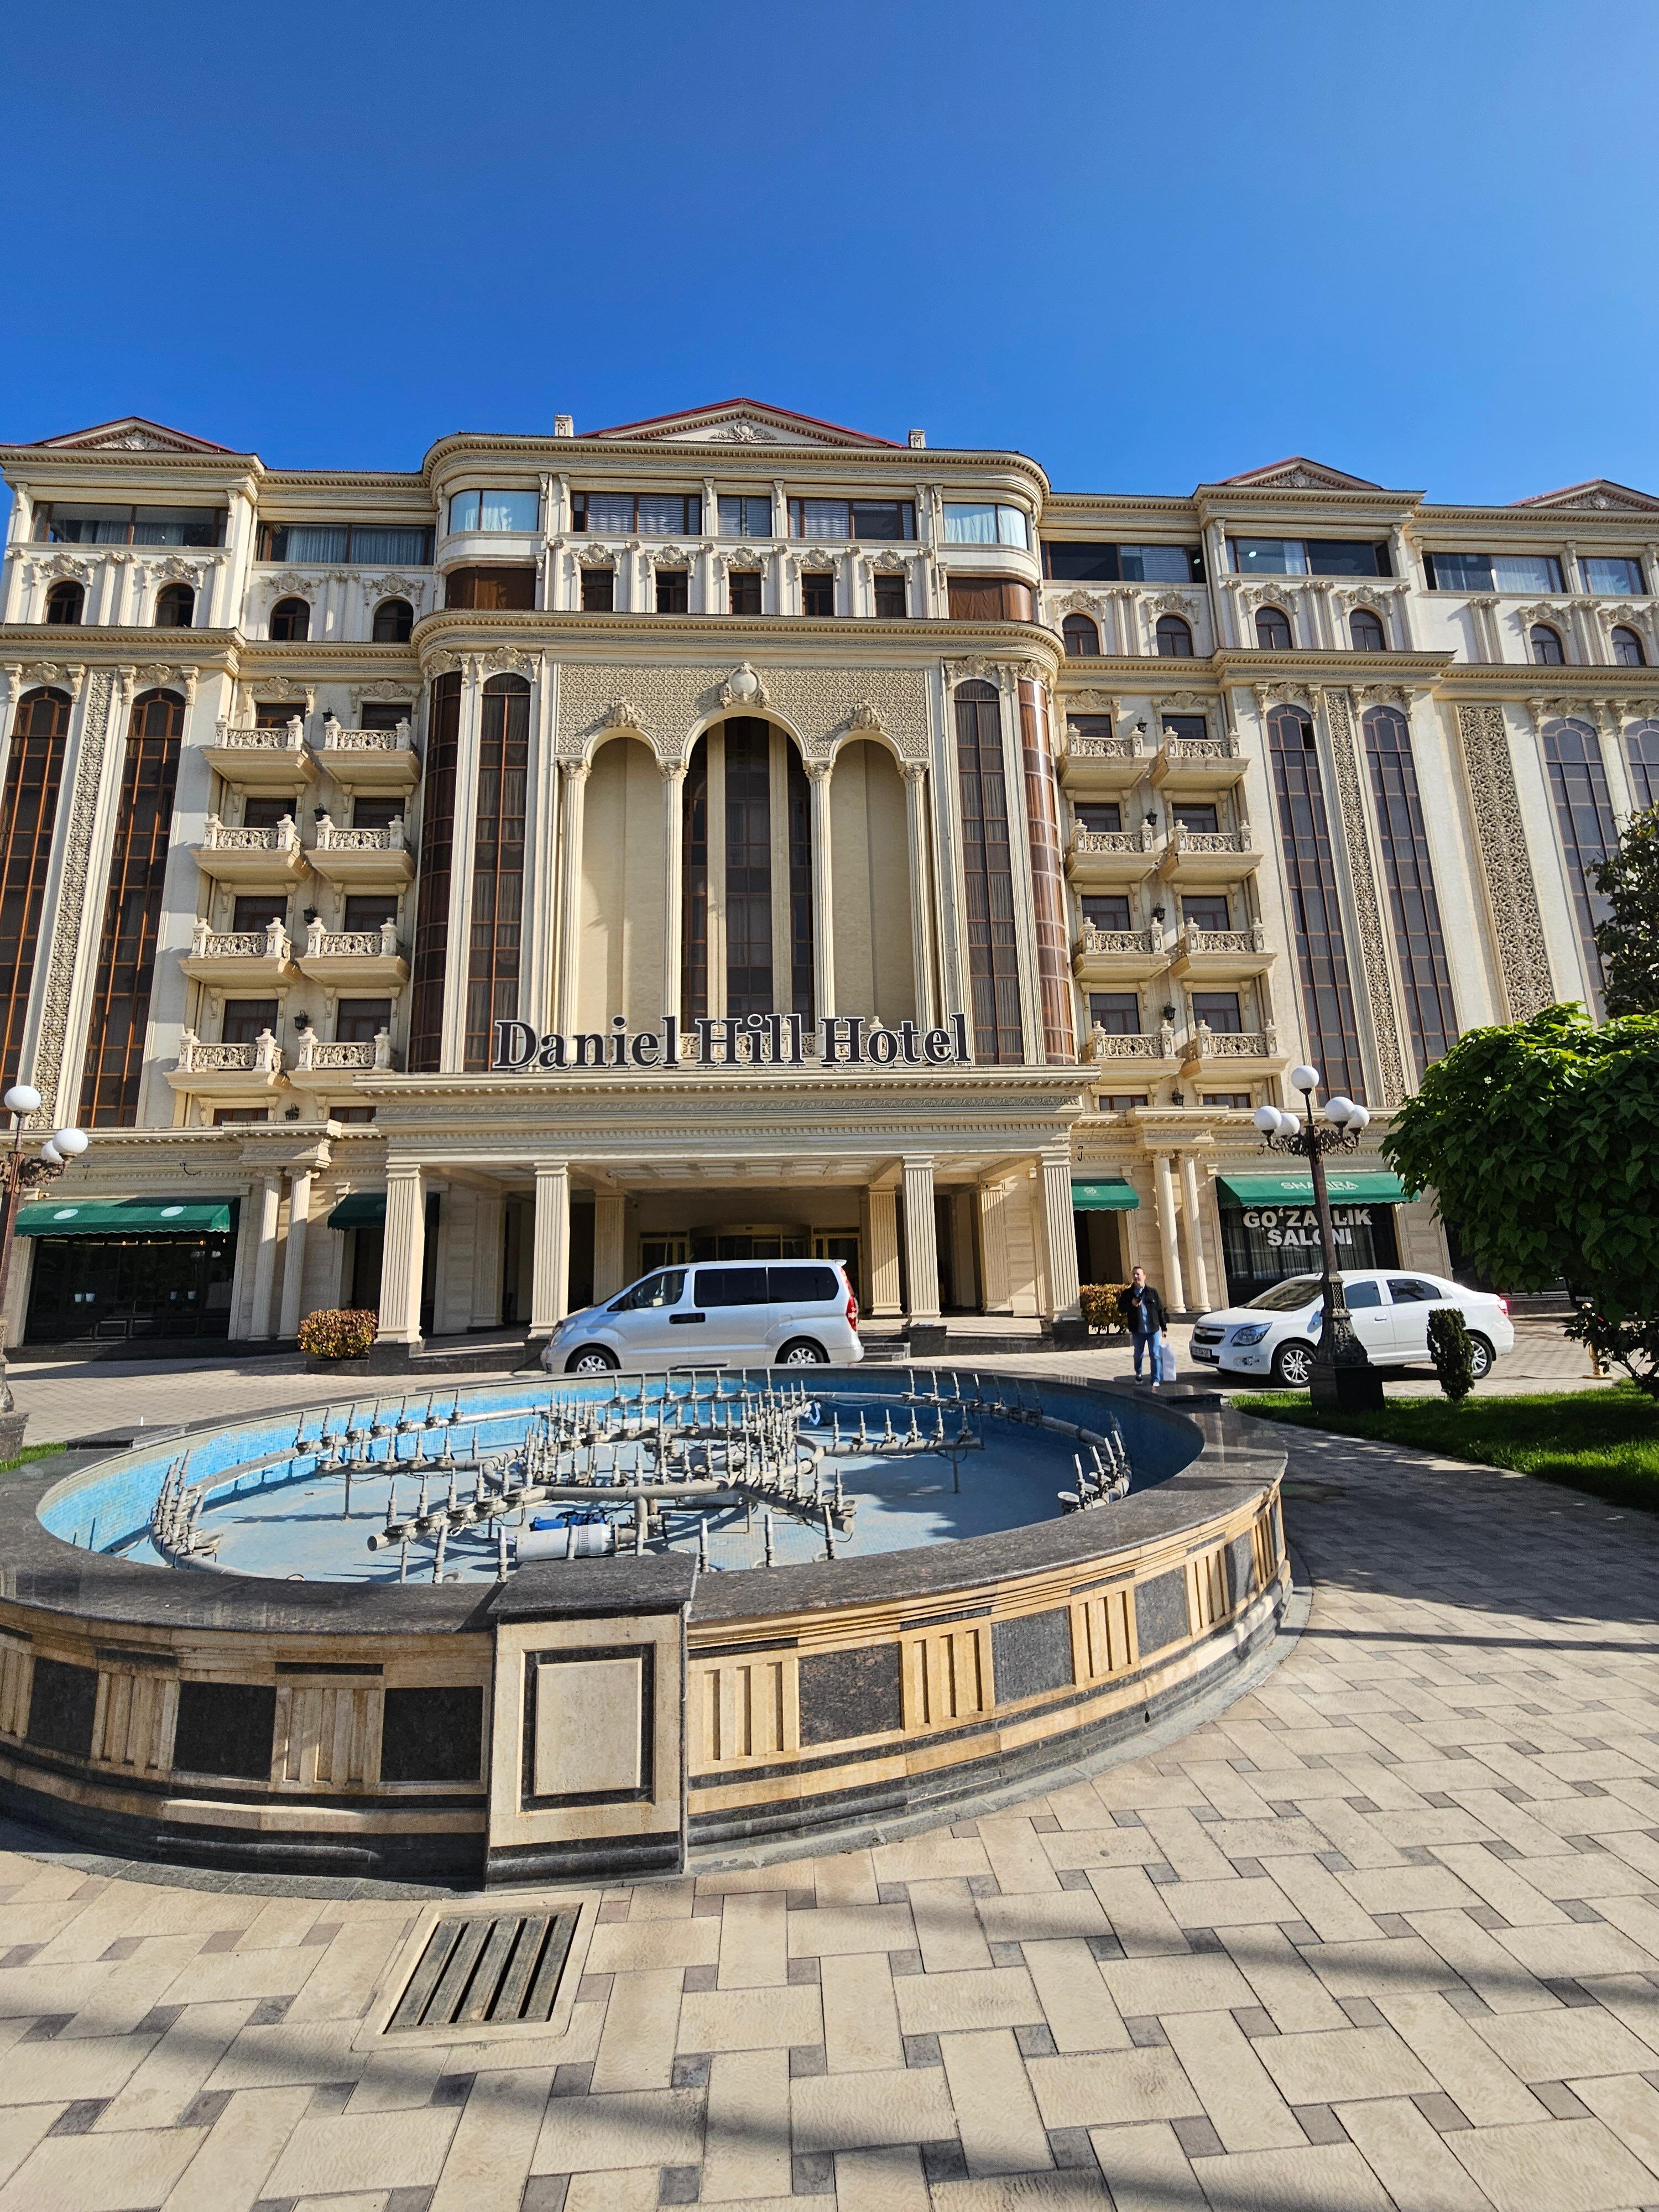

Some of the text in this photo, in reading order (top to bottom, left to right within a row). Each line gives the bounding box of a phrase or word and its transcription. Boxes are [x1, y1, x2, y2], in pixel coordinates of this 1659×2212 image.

[492, 1013, 971, 1070] Daniel Hill Hotel
[1281, 1181, 1359, 1191] SHAIRA
[1243, 1208, 1372, 1228] GO‘ZALIK
